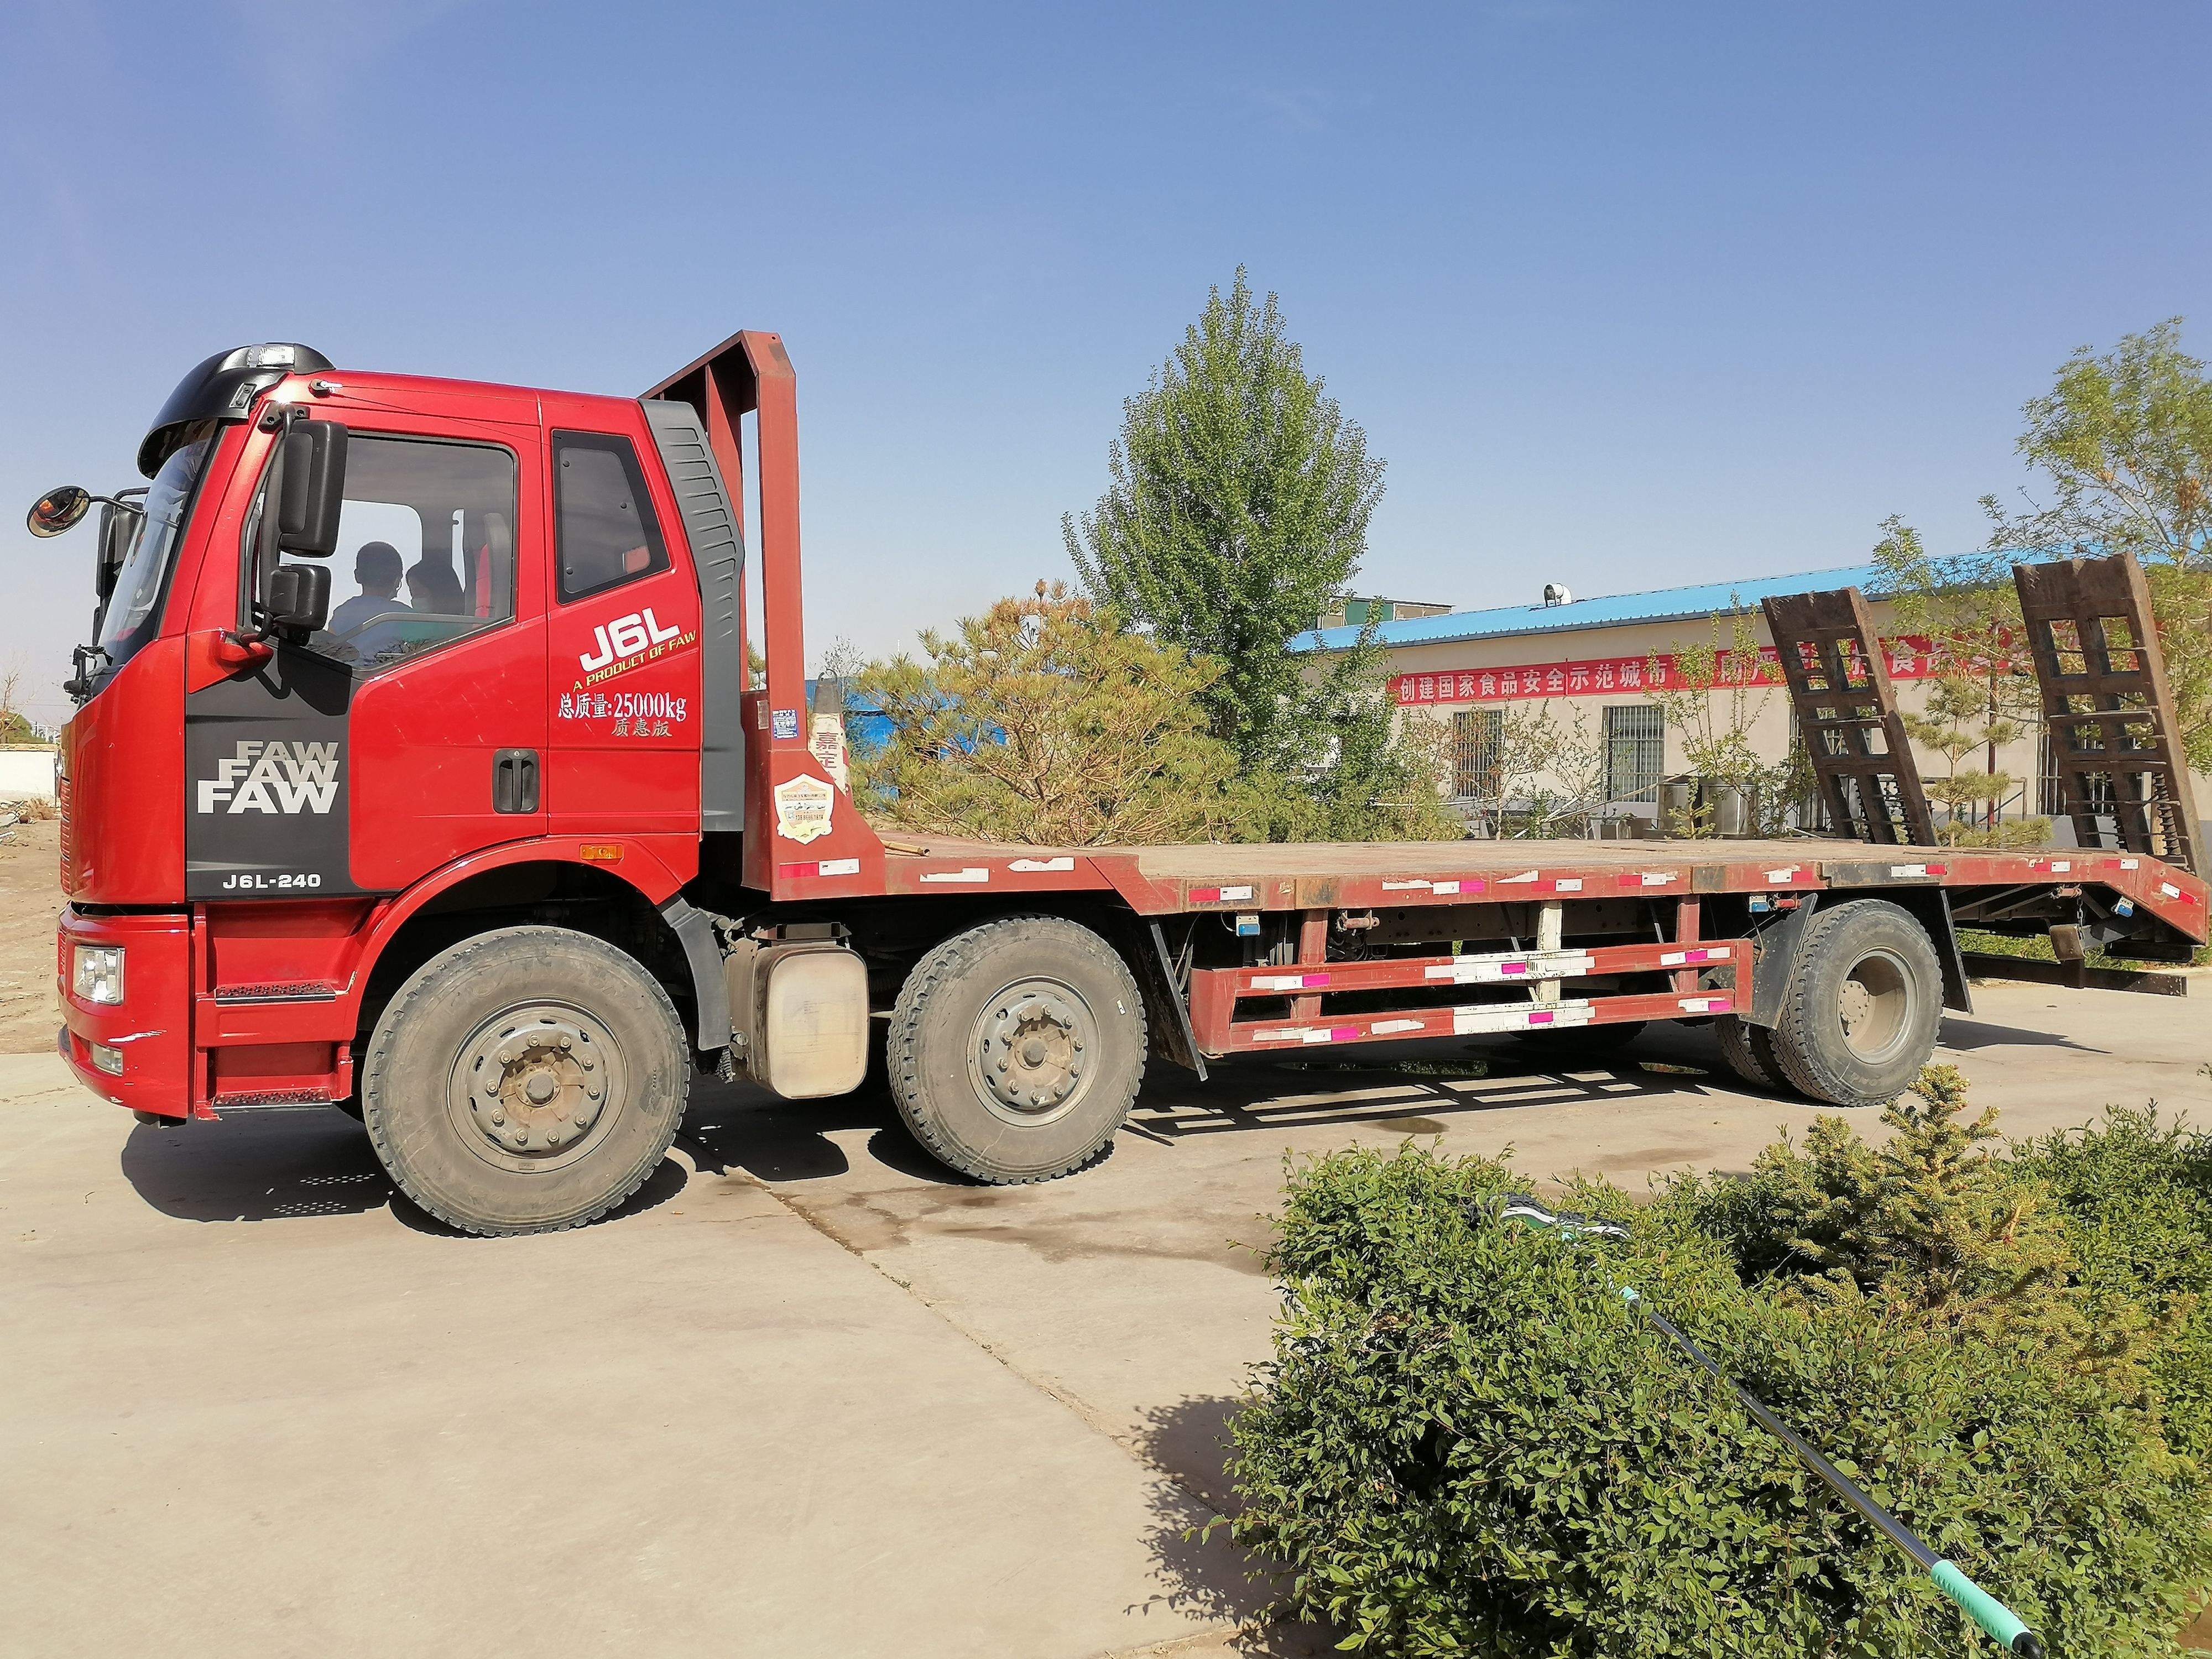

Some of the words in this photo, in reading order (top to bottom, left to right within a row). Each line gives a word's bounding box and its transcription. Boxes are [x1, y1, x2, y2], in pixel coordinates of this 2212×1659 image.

[579, 607, 680, 672] J6L
[573, 680, 583, 692] A
[586, 651, 645, 686] PRODUCT
[649, 643, 665, 659] OF
[669, 630, 696, 651] FAW
[1400, 660, 1667, 701] 创建国家食品安全示范城市
[611, 718, 672, 737] 质惠版
[237, 740, 338, 765] FAW
[219, 759, 338, 787] FAW
[197, 780, 338, 813] FAW
[223, 874, 321, 889] J6L-240
